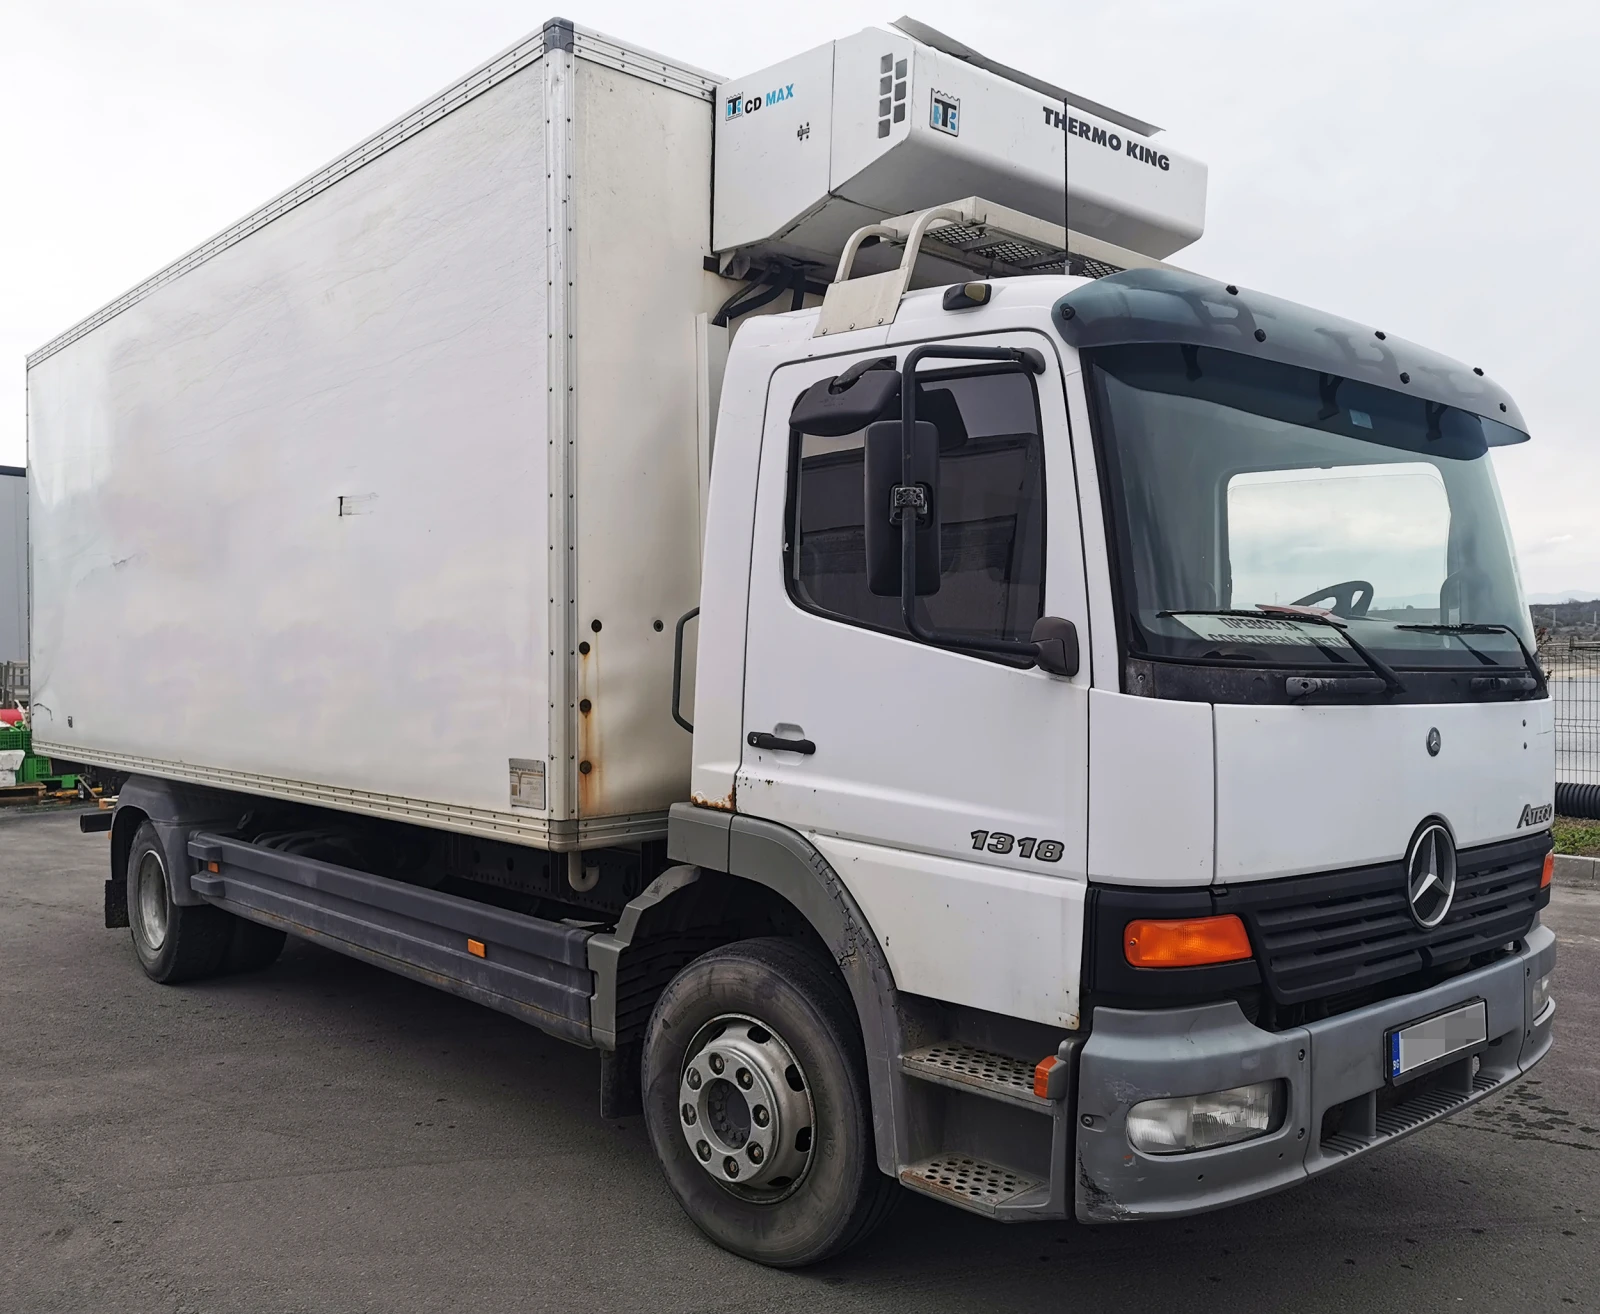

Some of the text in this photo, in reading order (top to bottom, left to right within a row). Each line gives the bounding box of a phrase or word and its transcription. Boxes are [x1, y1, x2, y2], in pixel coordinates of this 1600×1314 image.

[744, 96, 762, 114] CD
[765, 83, 794, 107] MAX
[1042, 106, 1170, 171] THERMO KING
[1217, 617, 1304, 632] ПРЕВОЗ ЗА
[970, 829, 1065, 862] 1318
